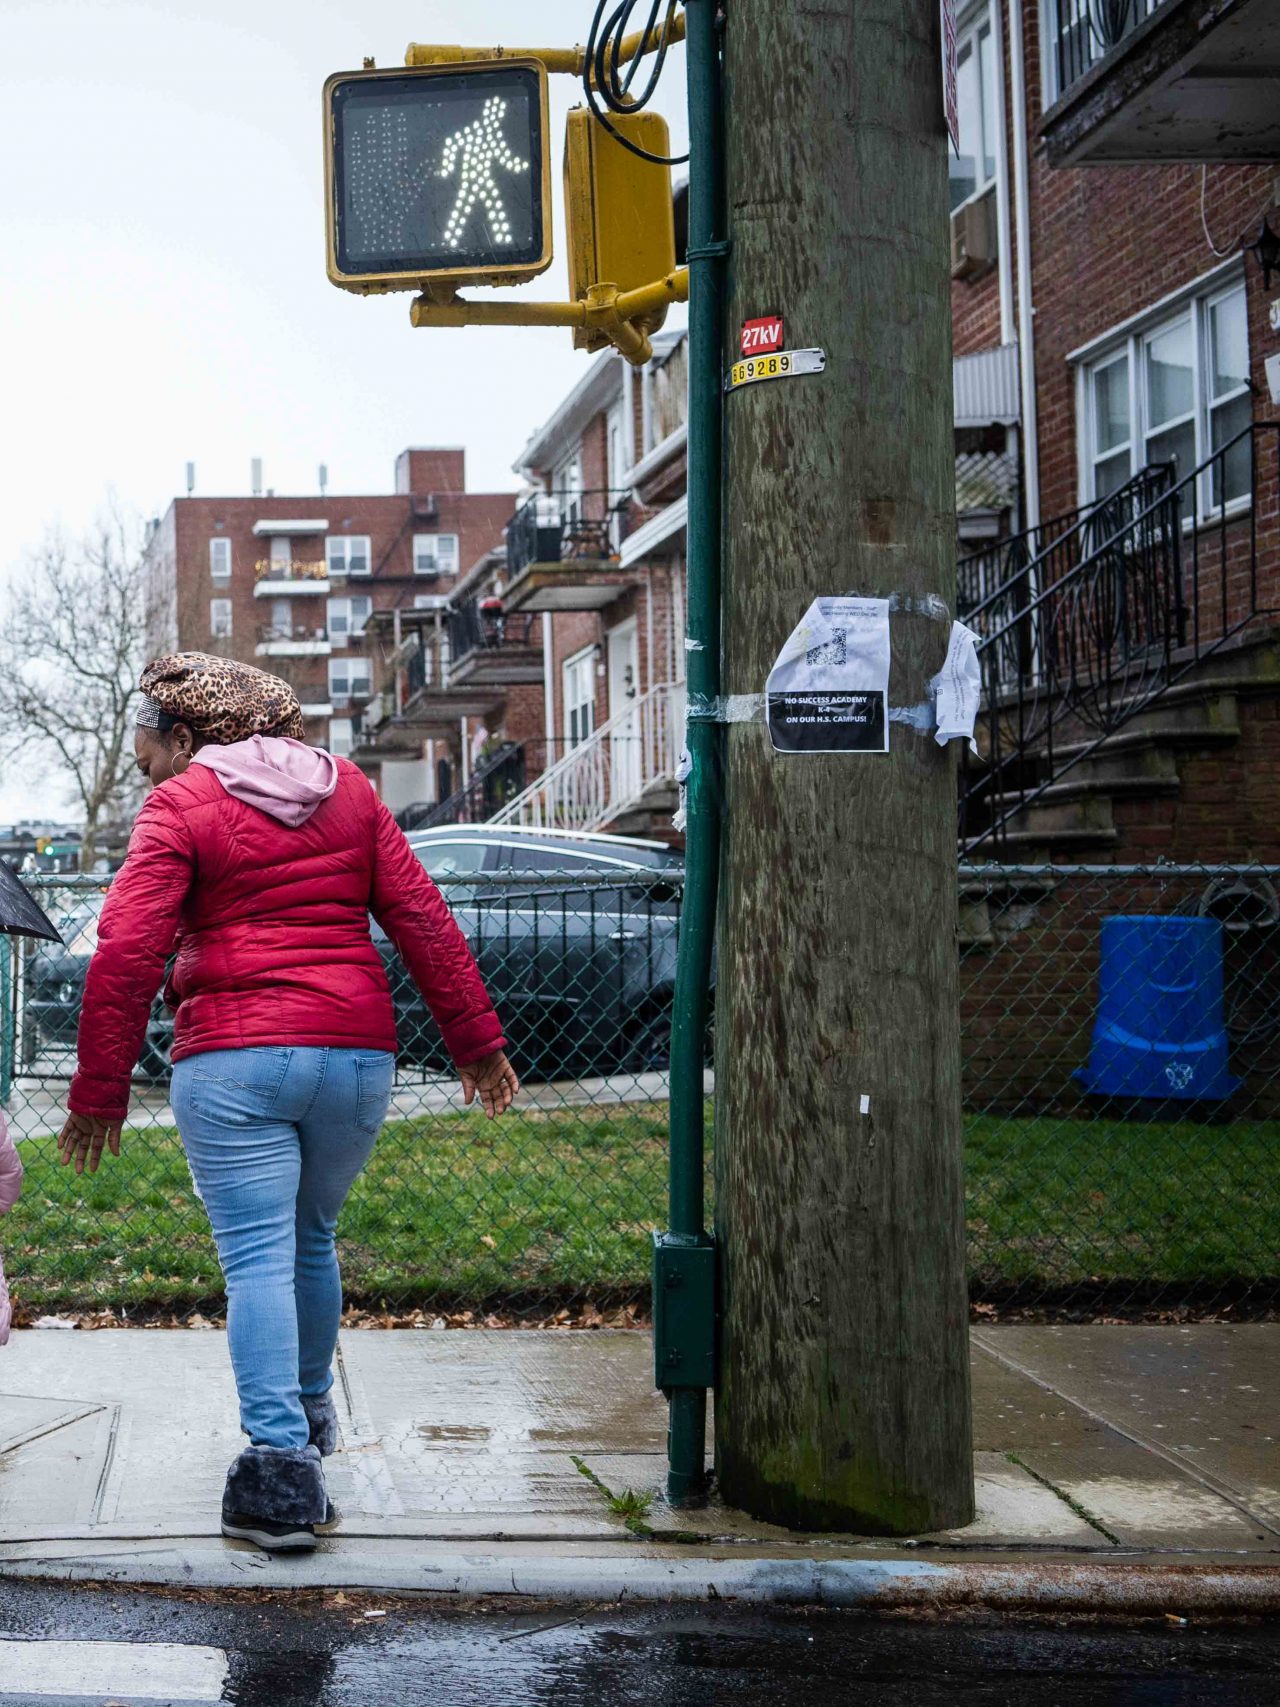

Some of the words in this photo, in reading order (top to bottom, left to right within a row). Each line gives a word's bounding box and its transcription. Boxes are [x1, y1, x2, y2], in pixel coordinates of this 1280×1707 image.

[742, 324, 780, 349] 27kV
[831, 696, 867, 704] ACADEMY
[832, 715, 867, 723] CAMPUS!
